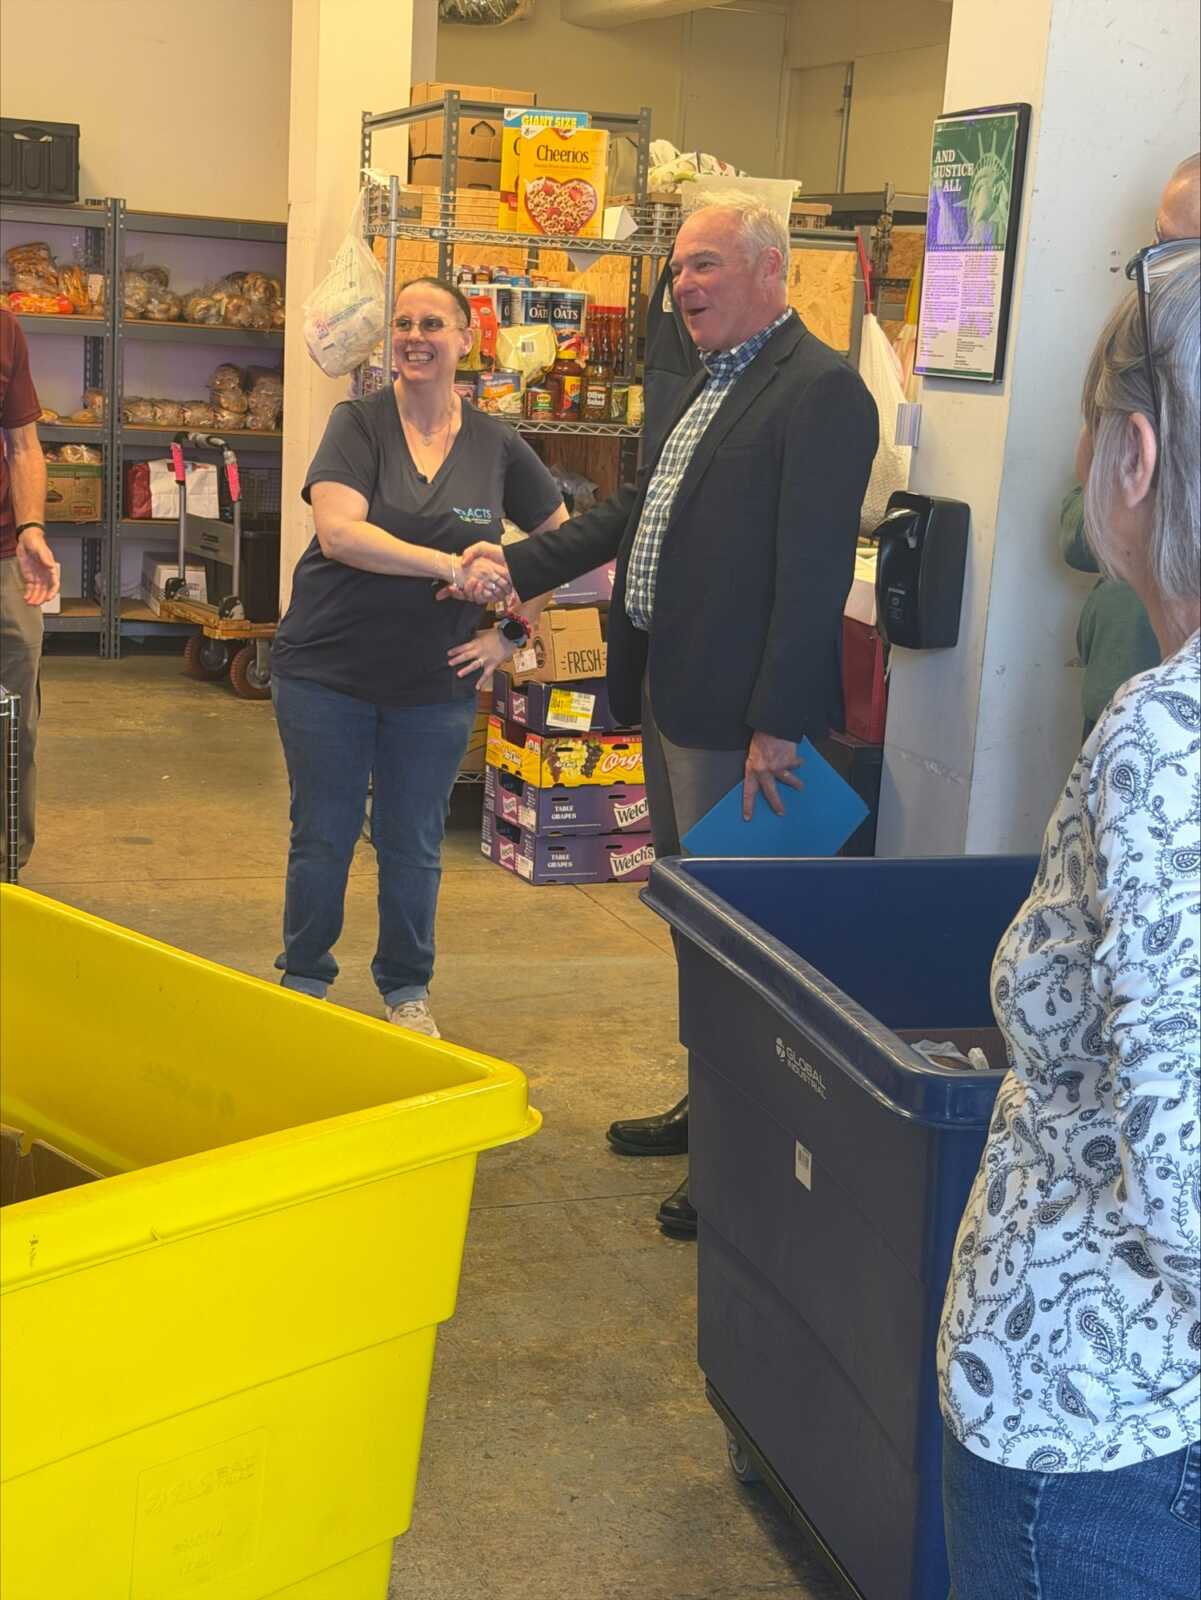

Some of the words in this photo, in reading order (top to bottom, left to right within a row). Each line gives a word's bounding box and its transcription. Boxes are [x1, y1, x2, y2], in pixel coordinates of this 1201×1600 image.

[521, 114, 553, 128] GIANT
[554, 116, 577, 129] SIZE
[536, 144, 589, 164] Cheerios
[934, 149, 956, 164] AND
[933, 163, 975, 178] JUSTICE
[943, 179, 962, 192] ALL
[553, 308, 579, 320] OATS
[567, 650, 602, 674] FRESH
[611, 847, 655, 873] Welch's
